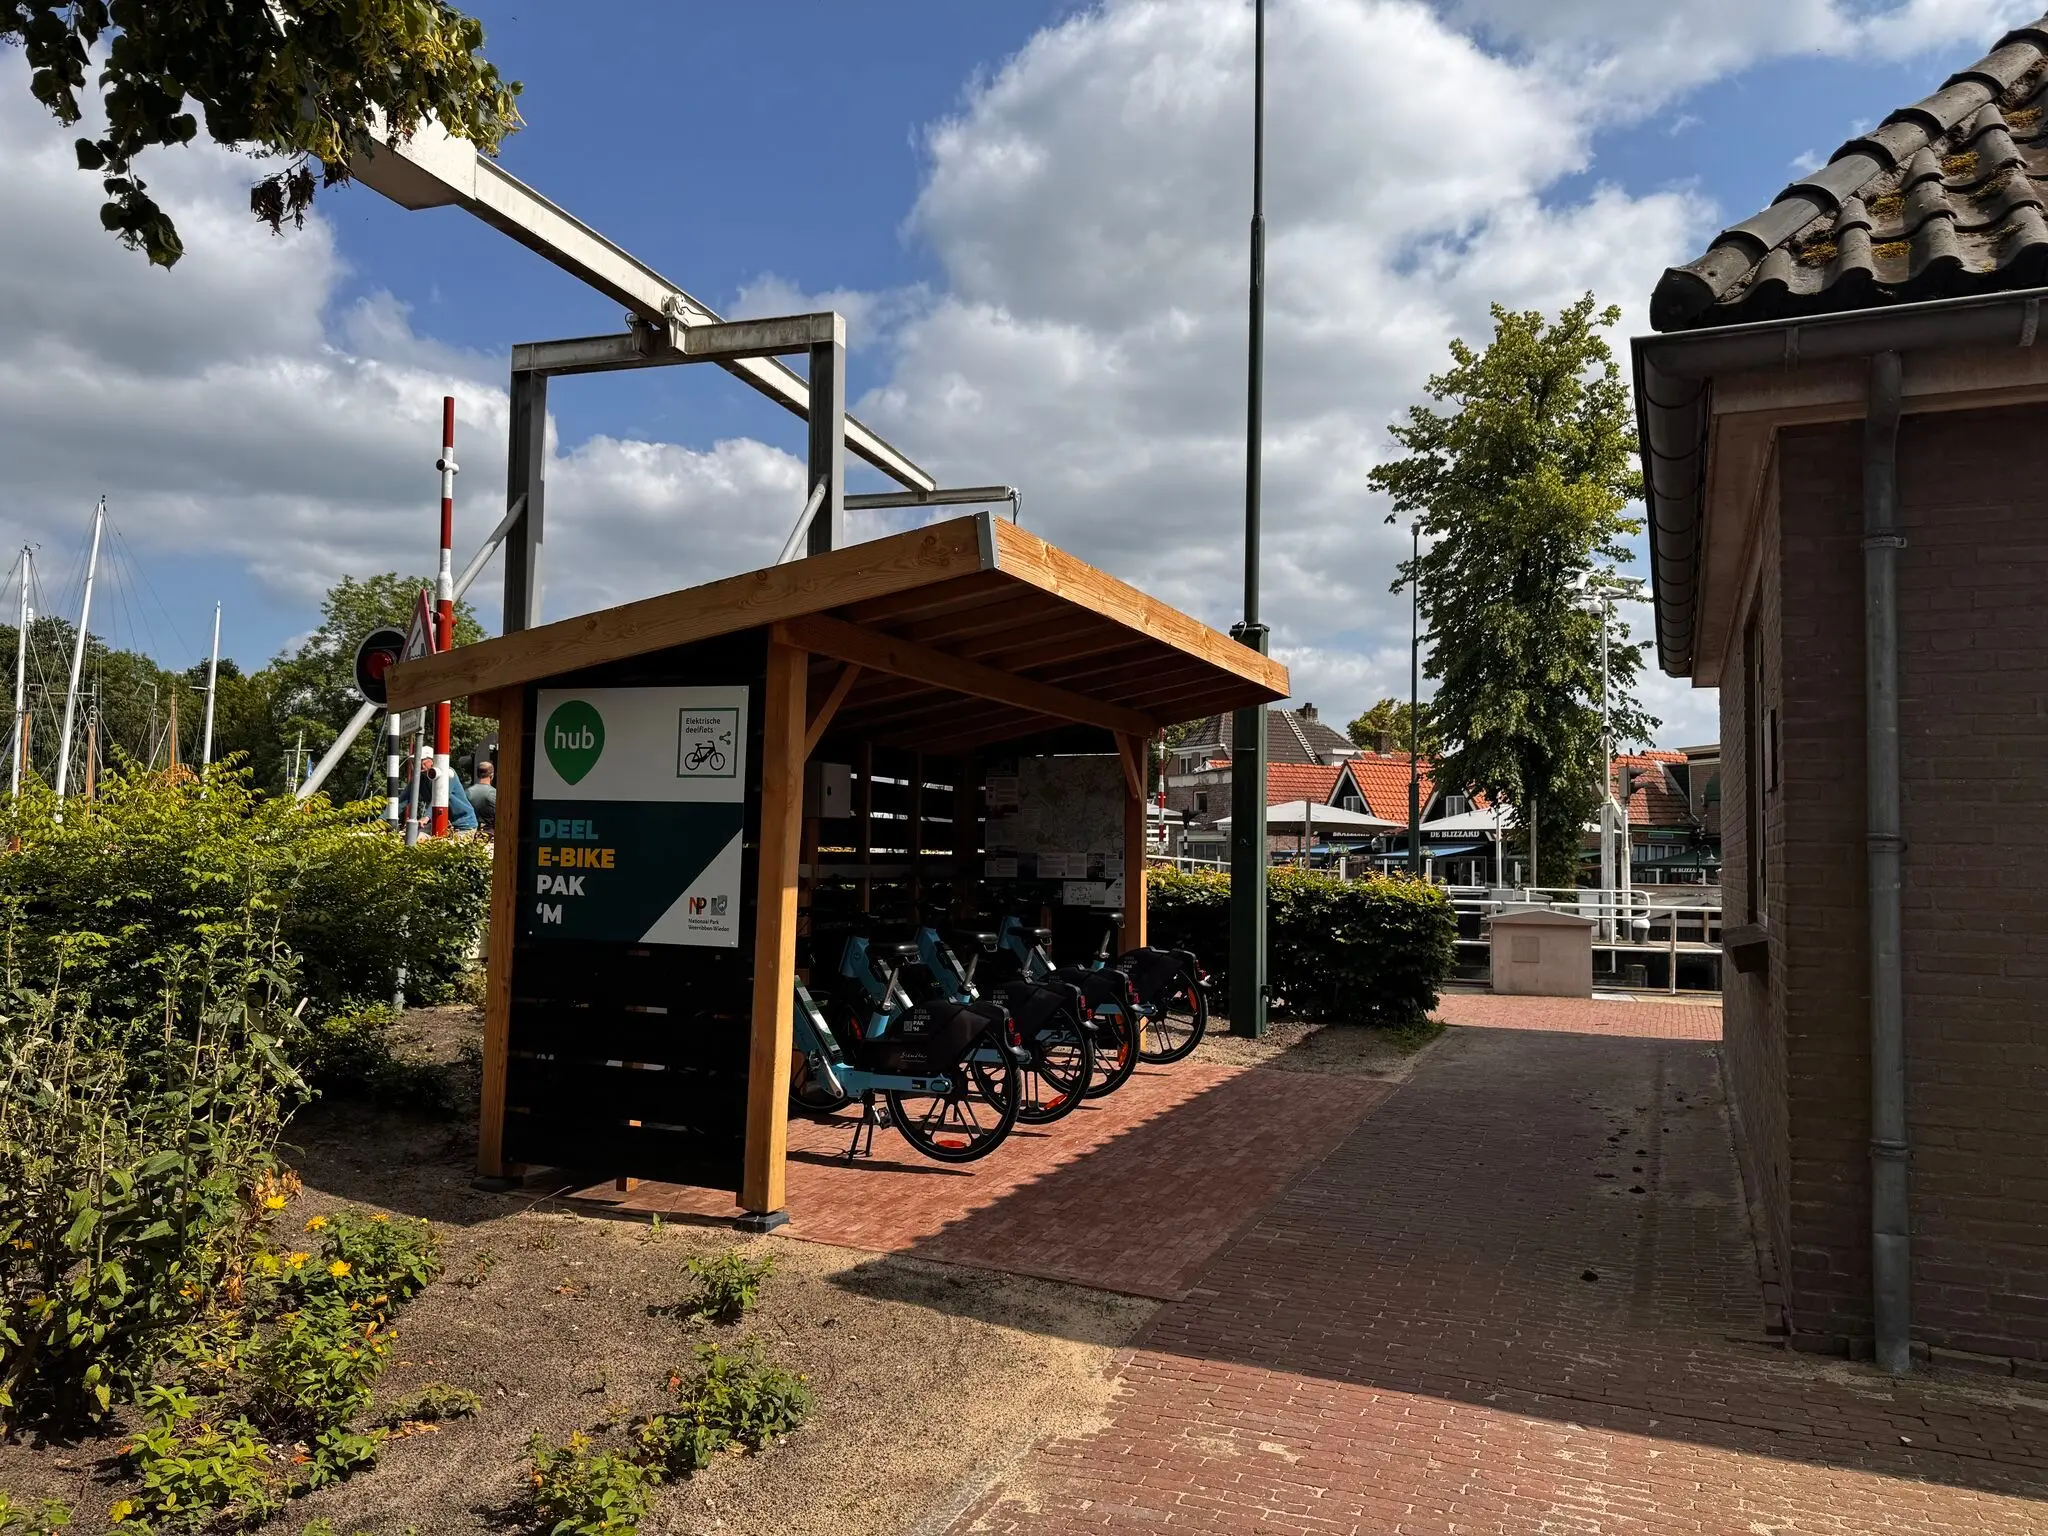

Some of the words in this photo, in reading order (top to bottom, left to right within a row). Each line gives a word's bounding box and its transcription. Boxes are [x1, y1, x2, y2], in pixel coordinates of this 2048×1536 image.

[685, 717, 721, 725] Elektrische
[685, 725, 714, 733] deelfiets
[554, 725, 596, 749] hub
[539, 819, 599, 840] DEEL
[538, 846, 616, 869] E-BIKE
[536, 874, 586, 896] PAK
